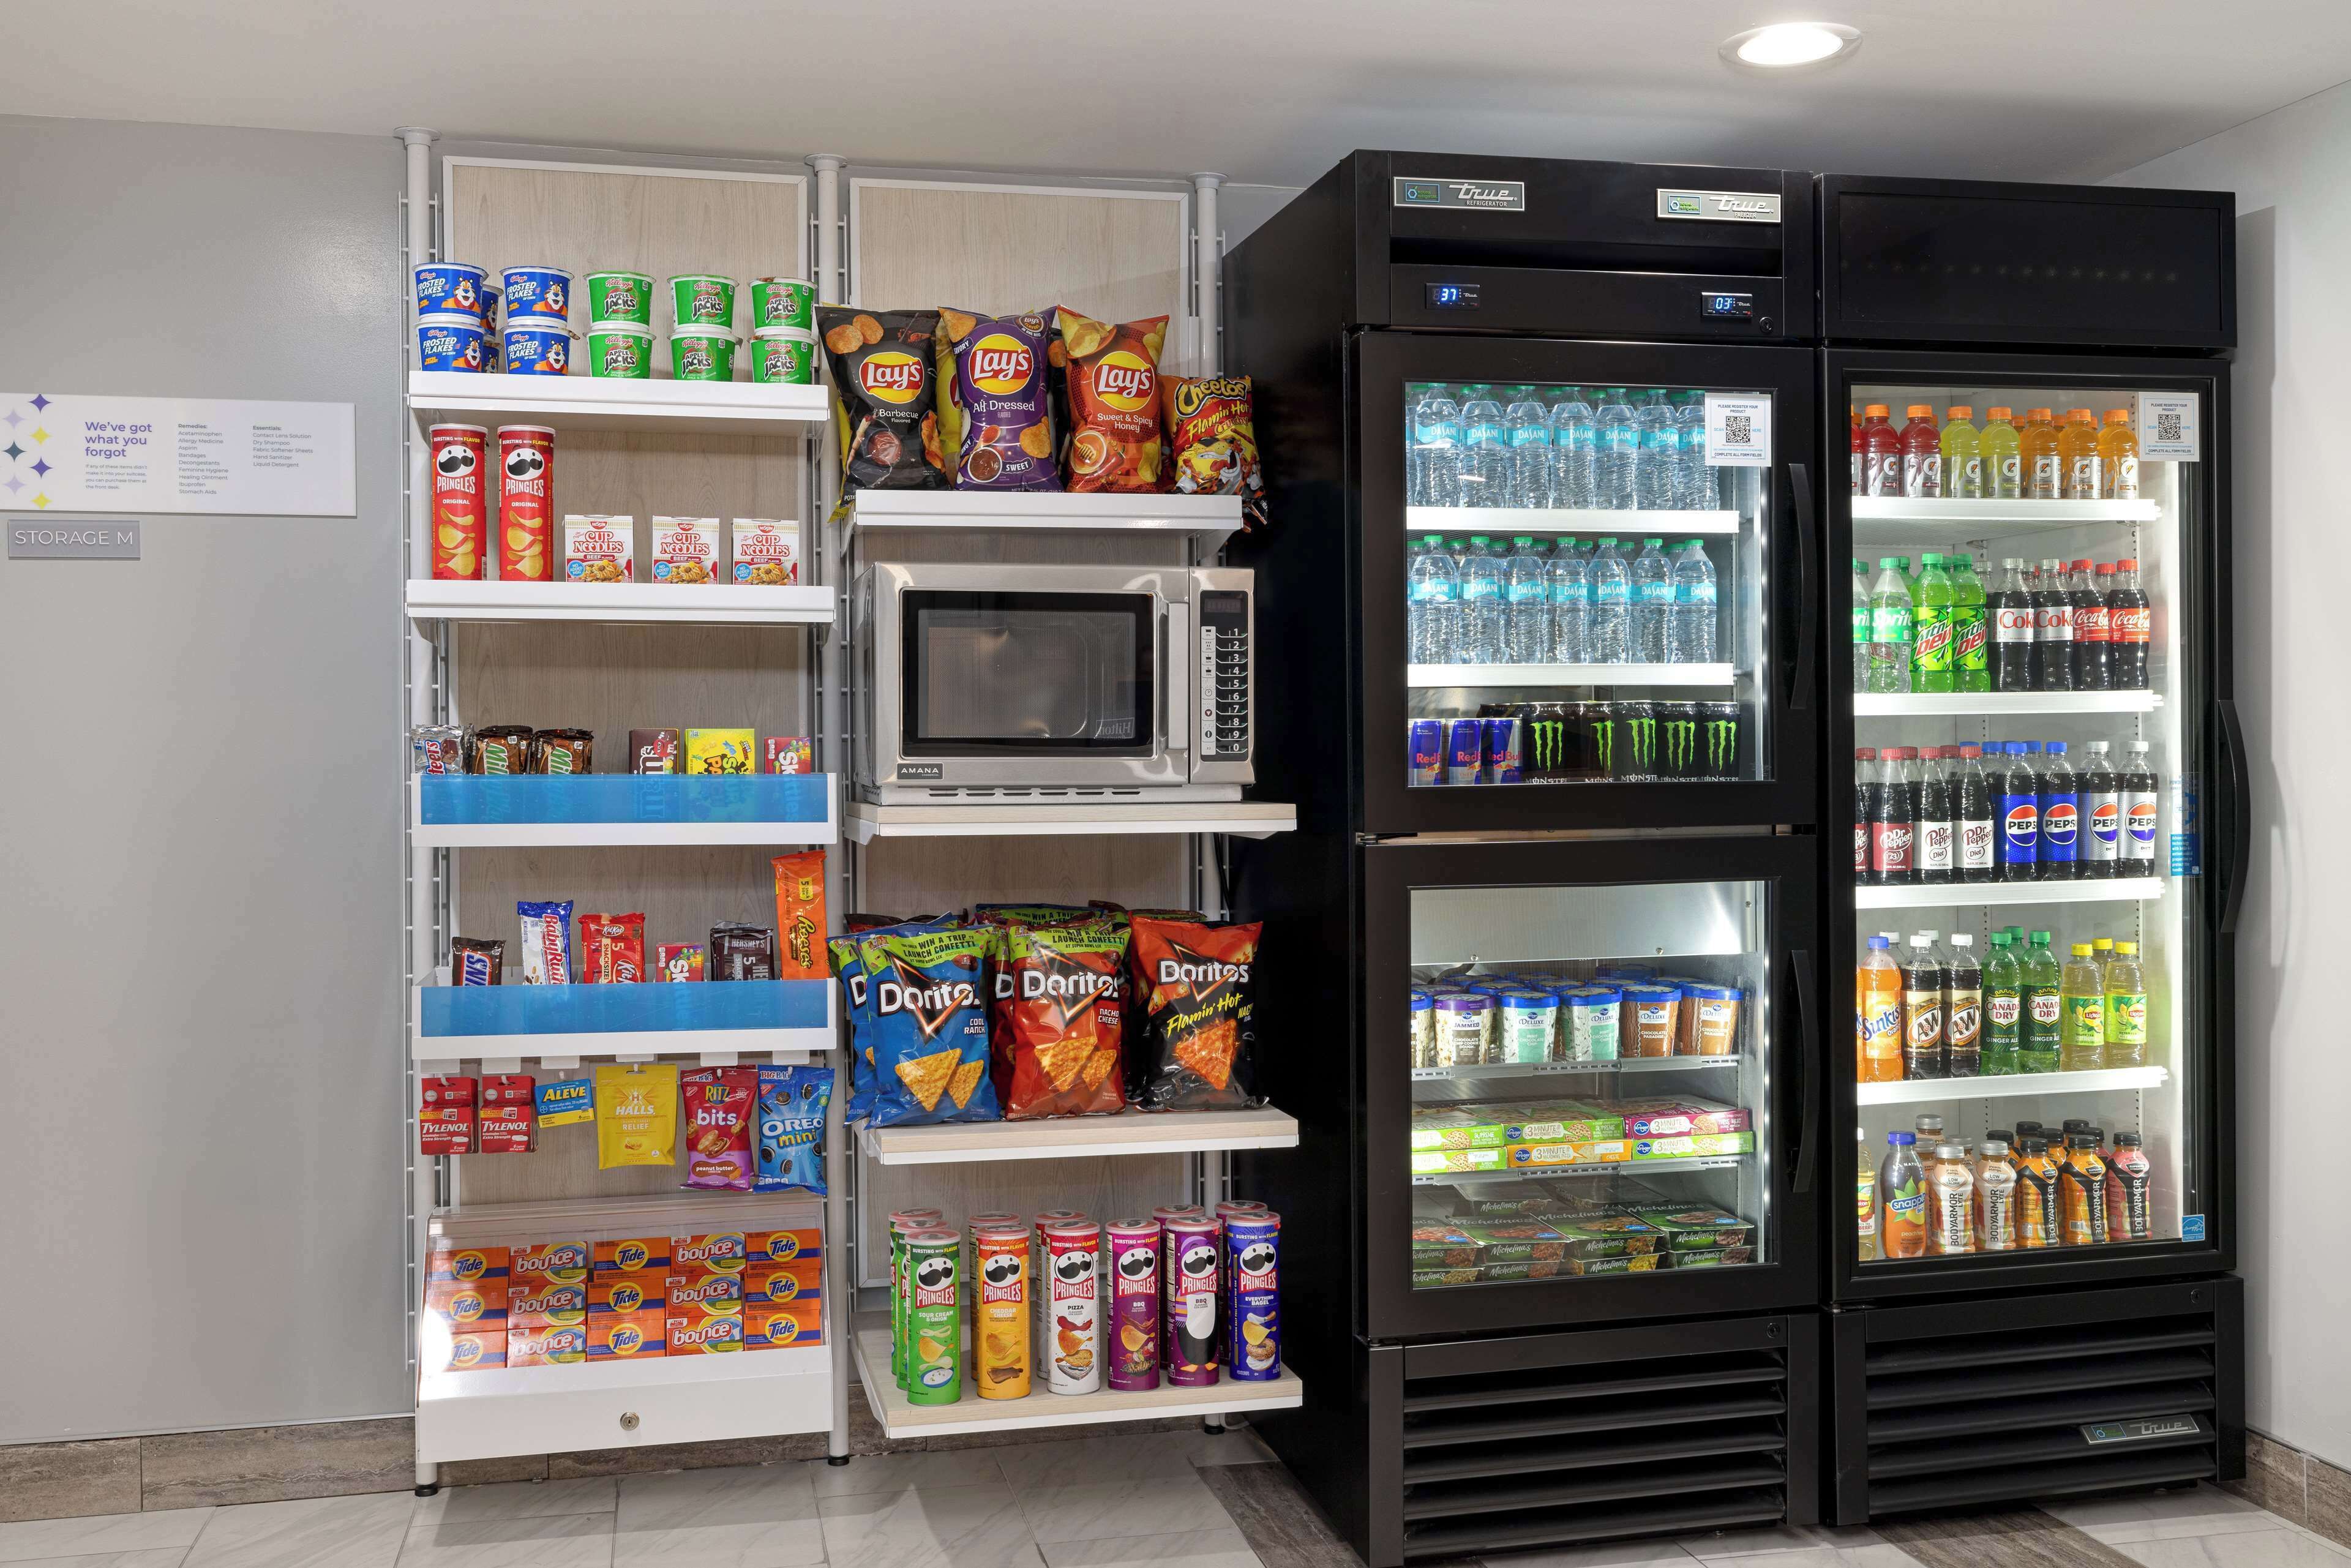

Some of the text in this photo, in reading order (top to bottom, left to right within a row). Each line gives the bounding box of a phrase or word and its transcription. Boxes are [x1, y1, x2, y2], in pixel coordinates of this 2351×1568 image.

[418, 278, 445, 292] FROSTED
[419, 285, 442, 298] FLAKES
[1441, 288, 1457, 301] 37
[604, 298, 637, 317] JACKS
[691, 301, 724, 320] JACKS
[423, 337, 457, 348] FROSTED
[424, 344, 453, 354] FLAKES
[974, 349, 1030, 380] Lay's
[866, 361, 920, 390] Lay's
[1098, 364, 1150, 398] Lay's
[1177, 378, 1245, 415] Cheetos
[989, 399, 1035, 411] Dressed
[1229, 400, 1249, 415] Hot
[879, 408, 918, 418] Barbecue
[1097, 413, 1123, 421] Sweet
[1133, 415, 1152, 427] Spicy
[85, 422, 152, 434] We've got
[1115, 421, 1140, 433] Honey
[85, 434, 147, 446] what you
[1518, 428, 1544, 440] DASANI
[85, 447, 126, 459] forgot
[1006, 462, 1029, 471] SWEET
[437, 476, 475, 494] PRINGLES
[506, 479, 544, 497] PRINGLES
[15, 530, 133, 545] STORAGE M
[585, 531, 613, 542] CUP
[573, 540, 623, 553] NOODLES
[1518, 583, 1542, 595] DASANI
[1505, 751, 1523, 761] Bull
[1964, 828, 1992, 846] Pepper
[1976, 826, 1987, 836] Dr
[602, 925, 624, 934] KitKat
[732, 939, 764, 948] HERSHEY'S
[798, 916, 816, 969] Reese's
[918, 938, 935, 950] WIN
[904, 941, 975, 958] LAUNCH CONFETTI
[1160, 961, 1248, 983] Doritos
[1217, 992, 1242, 1011] Hot
[1985, 1000, 2020, 1010] CANADA
[1098, 1016, 1119, 1025] CHEESE
[1995, 1011, 2015, 1019] DRY
[543, 1086, 586, 1102] ALEVE
[705, 1086, 730, 1101] RITZ
[616, 1105, 654, 1115] HALLS
[697, 1109, 737, 1125] bits
[482, 1122, 528, 1132] TYLENOL
[763, 1118, 823, 1136] OREO
[1528, 1126, 1533, 1136] 3
[778, 1130, 817, 1147] mini
[1507, 1130, 1521, 1138] Kroger
[1480, 1202, 1517, 1212] Michelina's
[770, 1239, 796, 1256] Tide
[1586, 1239, 1624, 1251] Michelina's
[456, 1258, 483, 1275] Tide
[516, 1250, 574, 1274] bounce
[1241, 1272, 1275, 1290] PRINGLES
[984, 1283, 1021, 1302] PRINGLES
[1056, 1280, 1093, 1300] PRINGLES
